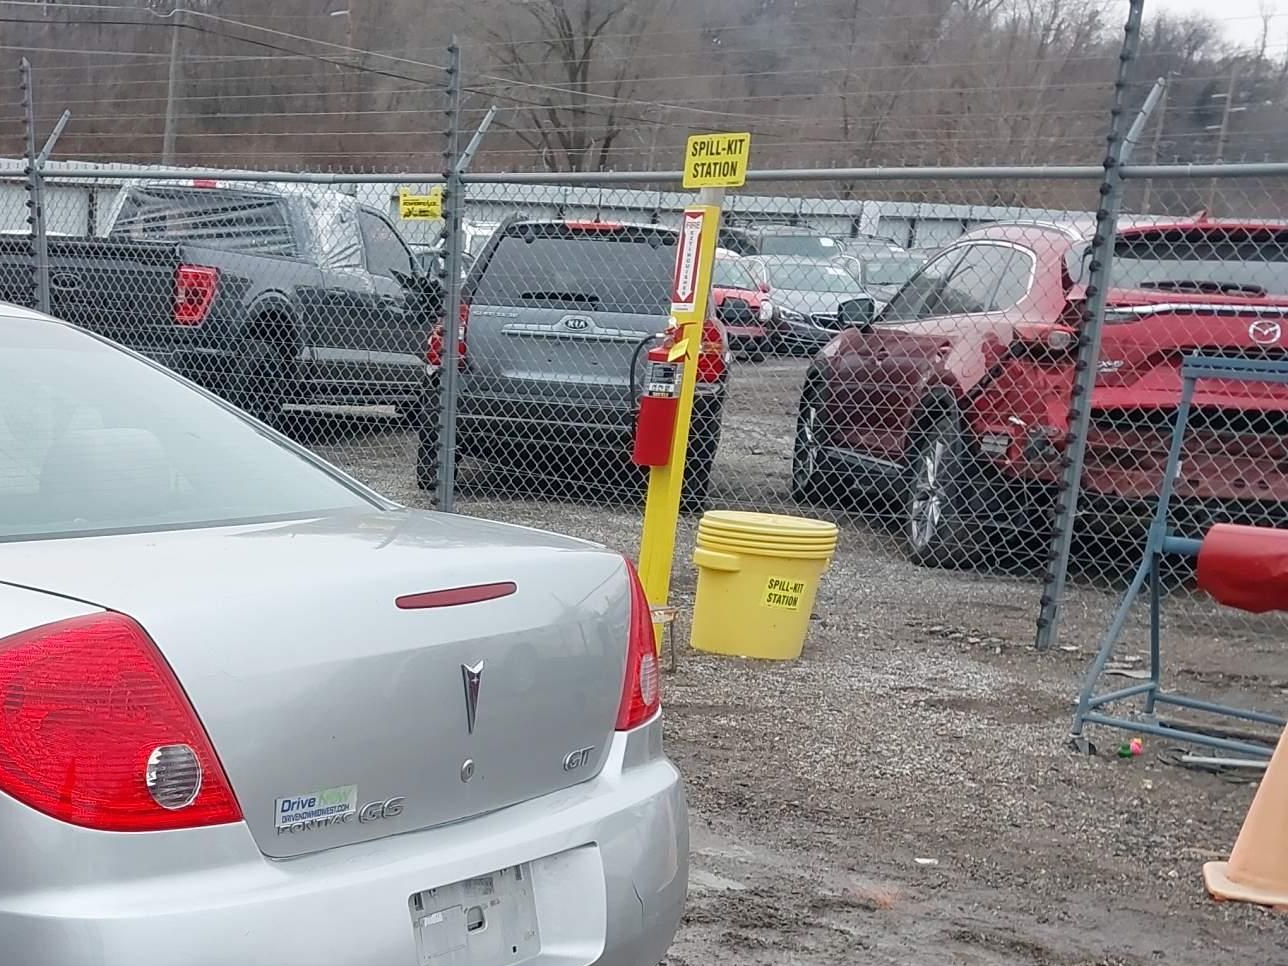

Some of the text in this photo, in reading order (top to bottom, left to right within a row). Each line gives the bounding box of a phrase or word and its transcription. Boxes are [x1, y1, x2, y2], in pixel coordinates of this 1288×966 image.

[691, 139, 745, 157] SPILL-KIT
[692, 161, 738, 178] STATION
[767, 578, 804, 594] SPILL-KIT
[766, 592, 799, 607] STATION
[562, 744, 595, 771] GT
[280, 797, 316, 813] Drive
[359, 796, 406, 823] G6
